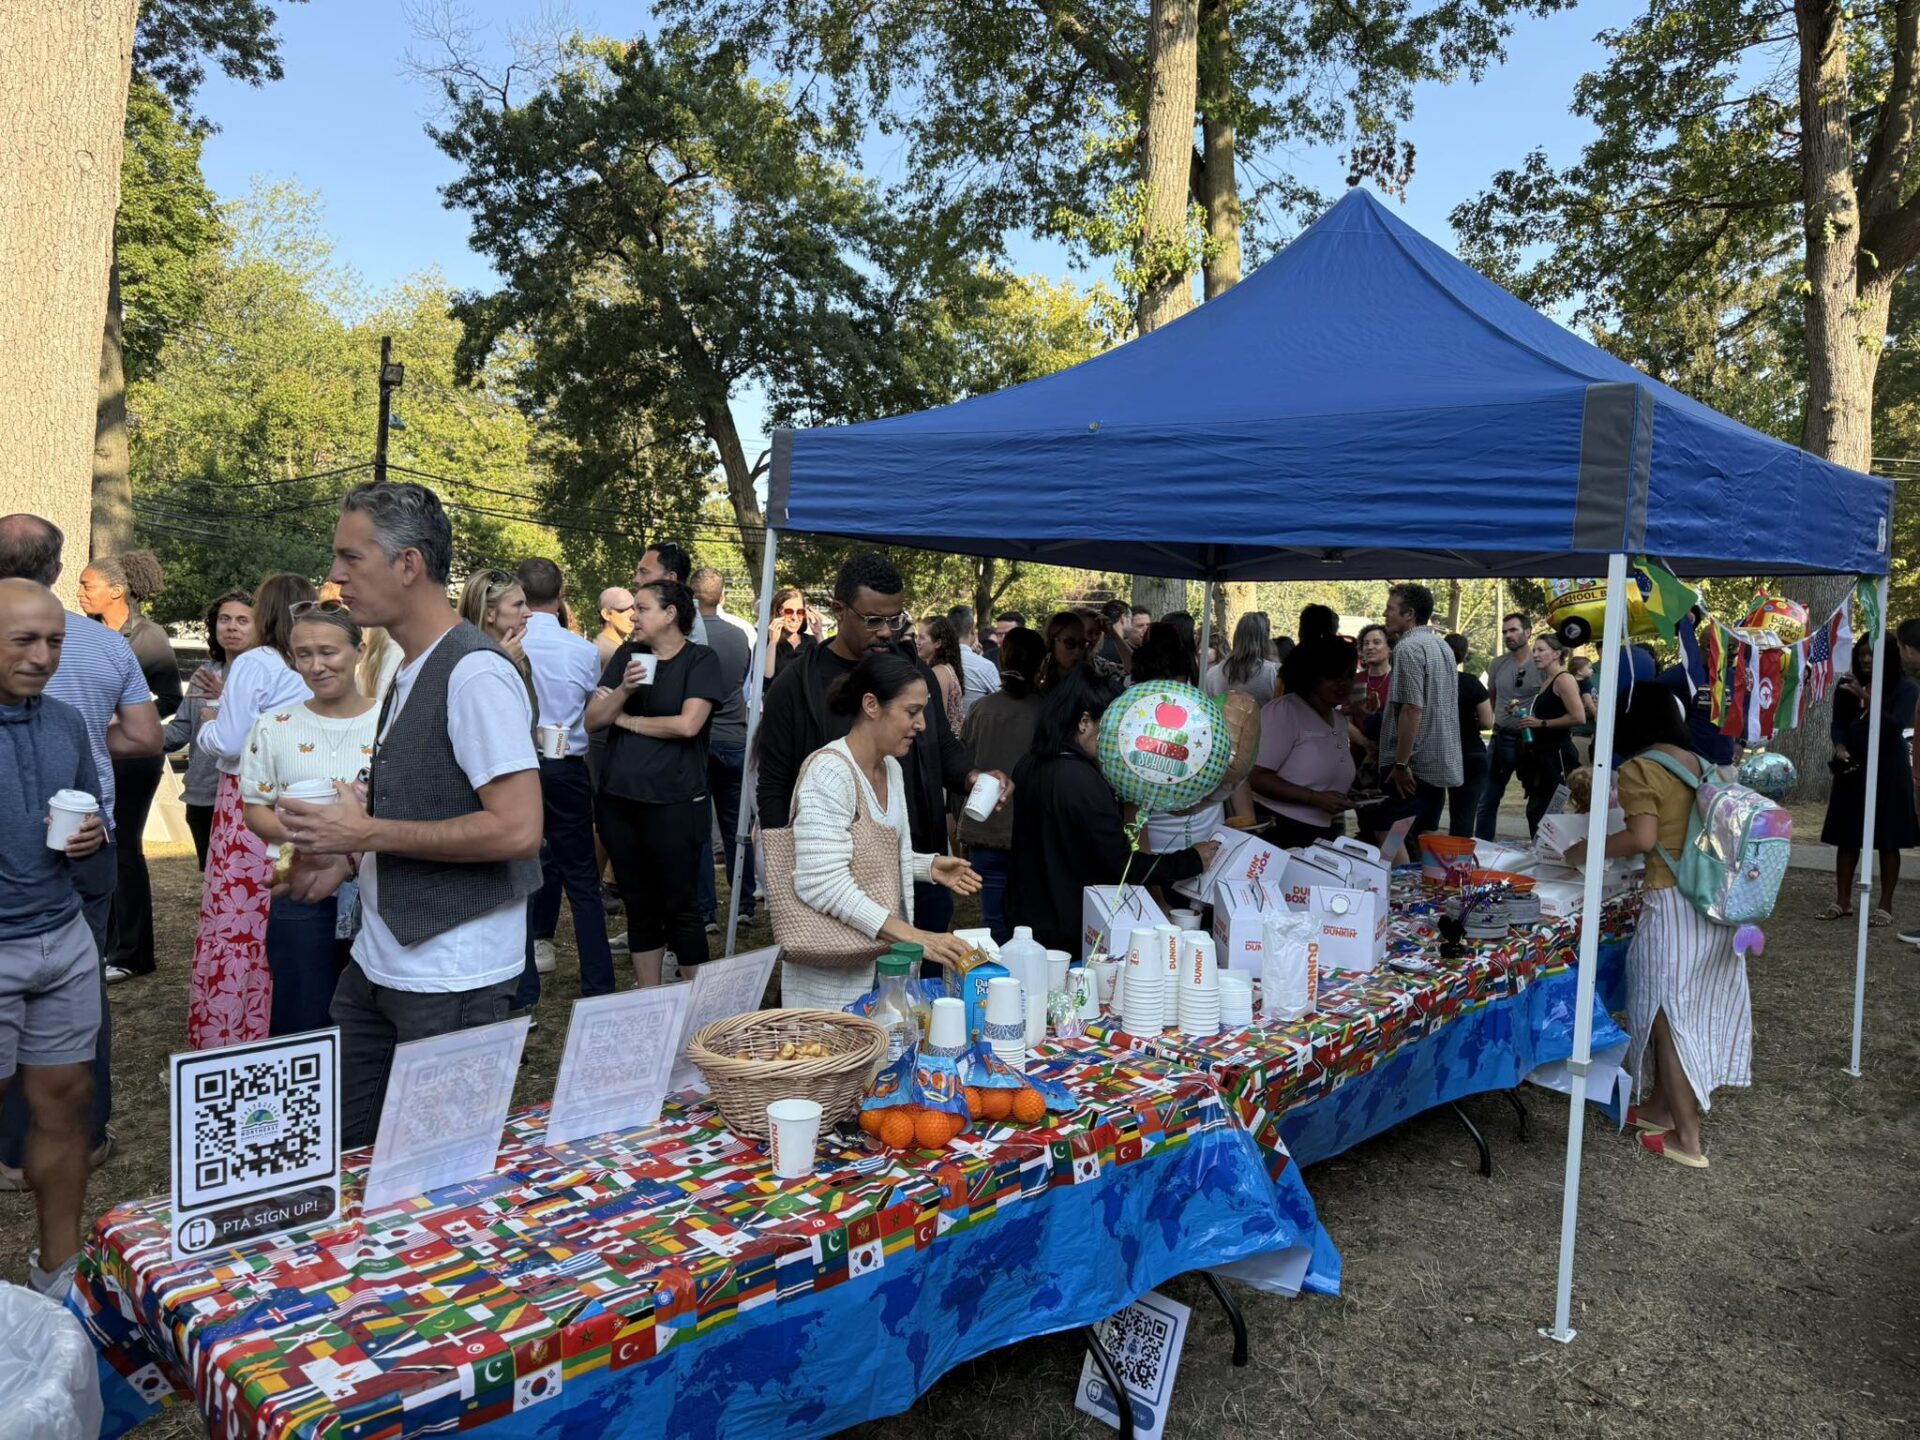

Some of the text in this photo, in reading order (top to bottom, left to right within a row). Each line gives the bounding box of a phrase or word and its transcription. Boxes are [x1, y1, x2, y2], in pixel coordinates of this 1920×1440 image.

[1559, 591, 1597, 603] SCHOOL
[1156, 740, 1168, 755] TO
[1138, 752, 1177, 775] SCHOOL
[1258, 850, 1271, 874] JOE
[1285, 893, 1306, 905] BOX
[223, 1200, 318, 1234] PTA SIGN UP!
